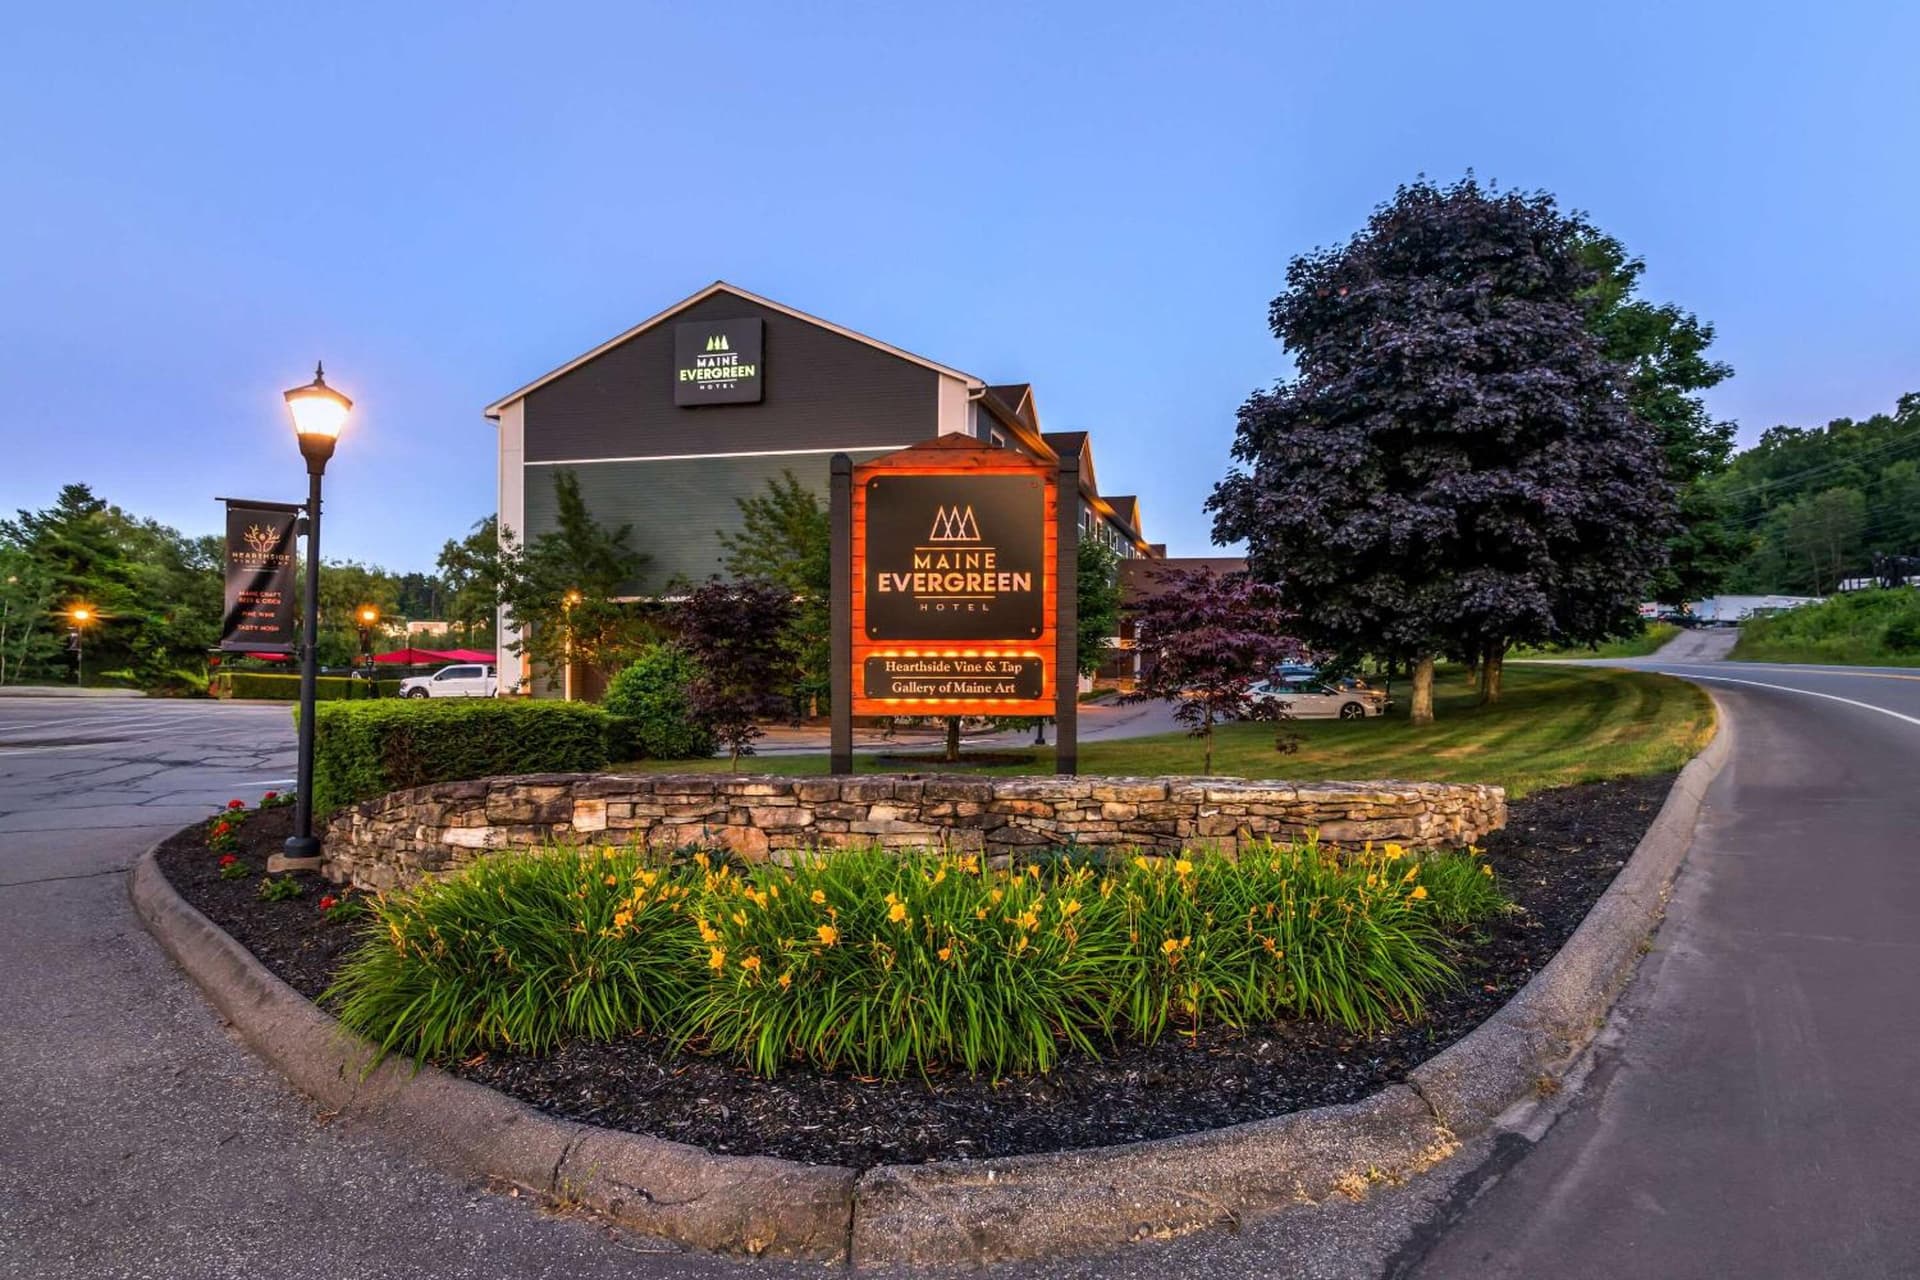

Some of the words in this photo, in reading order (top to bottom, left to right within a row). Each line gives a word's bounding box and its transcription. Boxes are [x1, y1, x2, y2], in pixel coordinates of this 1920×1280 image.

[697, 356, 738, 367] MAINE
[680, 365, 755, 381] EVERGREEN
[232, 552, 290, 560] HEARTHSIDE
[914, 553, 997, 569] MAINE
[878, 572, 1032, 592] EVERGREEN
[920, 603, 990, 612] HOTEL
[885, 661, 951, 673] Hearthside
[954, 661, 981, 673] Vine
[984, 661, 996, 673] &
[999, 661, 1023, 675] Tap
[892, 681, 936, 695] Gallery
[938, 681, 952, 693] of
[953, 681, 992, 694] Maine
[994, 682, 1016, 694] Art
